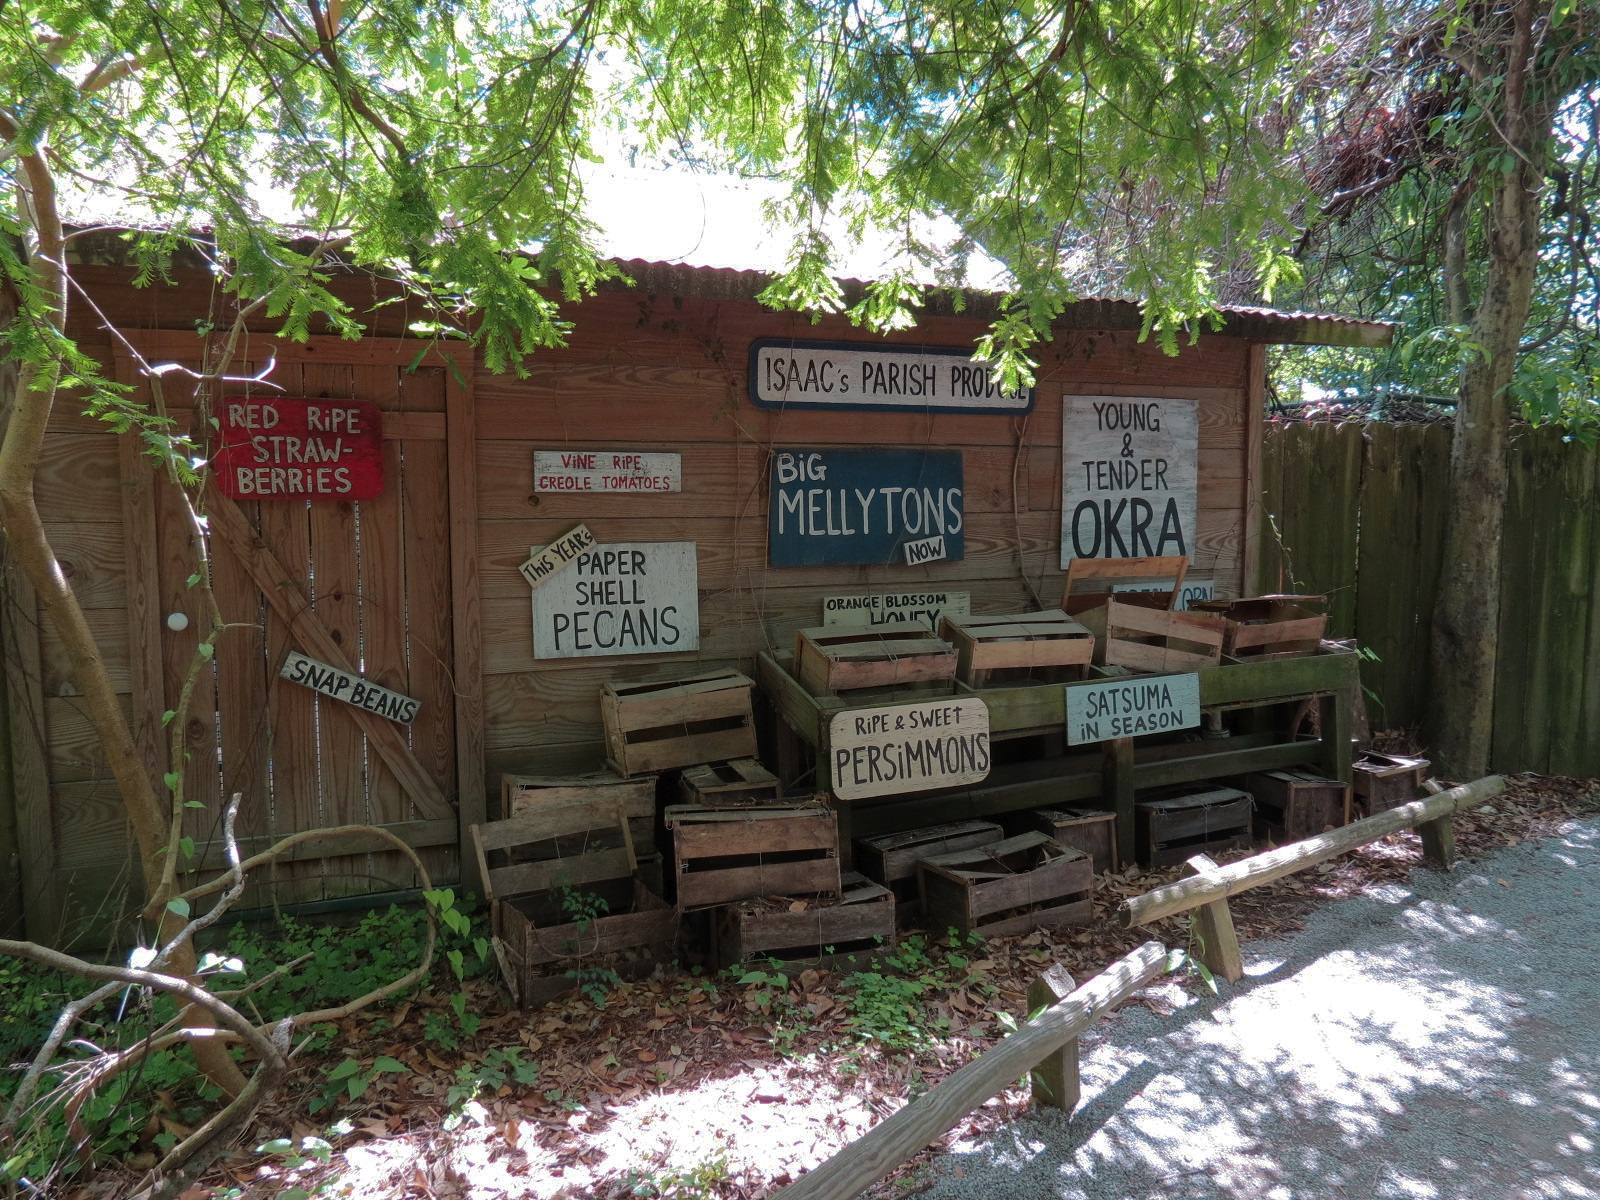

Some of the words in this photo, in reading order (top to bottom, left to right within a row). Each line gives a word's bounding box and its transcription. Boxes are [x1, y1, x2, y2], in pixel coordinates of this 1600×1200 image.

[765, 357, 849, 394] ISAAC's
[862, 360, 936, 397] PARISH
[951, 365, 1027, 400] PRODE
[229, 404, 280, 428] RED
[1093, 402, 1160, 432] YOUNG
[253, 435, 353, 463] STRAW-
[1121, 432, 1135, 458] &
[602, 476, 671, 490] TOMATOES
[1082, 458, 1169, 491] TENDER
[778, 487, 963, 536] MELLYTONS
[1071, 497, 1187, 559] OKRA
[576, 550, 647, 576] PAPER
[908, 538, 943, 564] NOW
[575, 579, 646, 606] SHELL
[826, 597, 880, 610] ORANGE
[885, 593, 947, 608] BLOSSOM
[553, 606, 680, 651] PECANS
[289, 659, 350, 696] SNAP
[350, 682, 417, 724] BEANS
[1086, 683, 1173, 719] SATSUMA
[894, 715, 906, 731] &
[1111, 709, 1184, 737] SEASON
